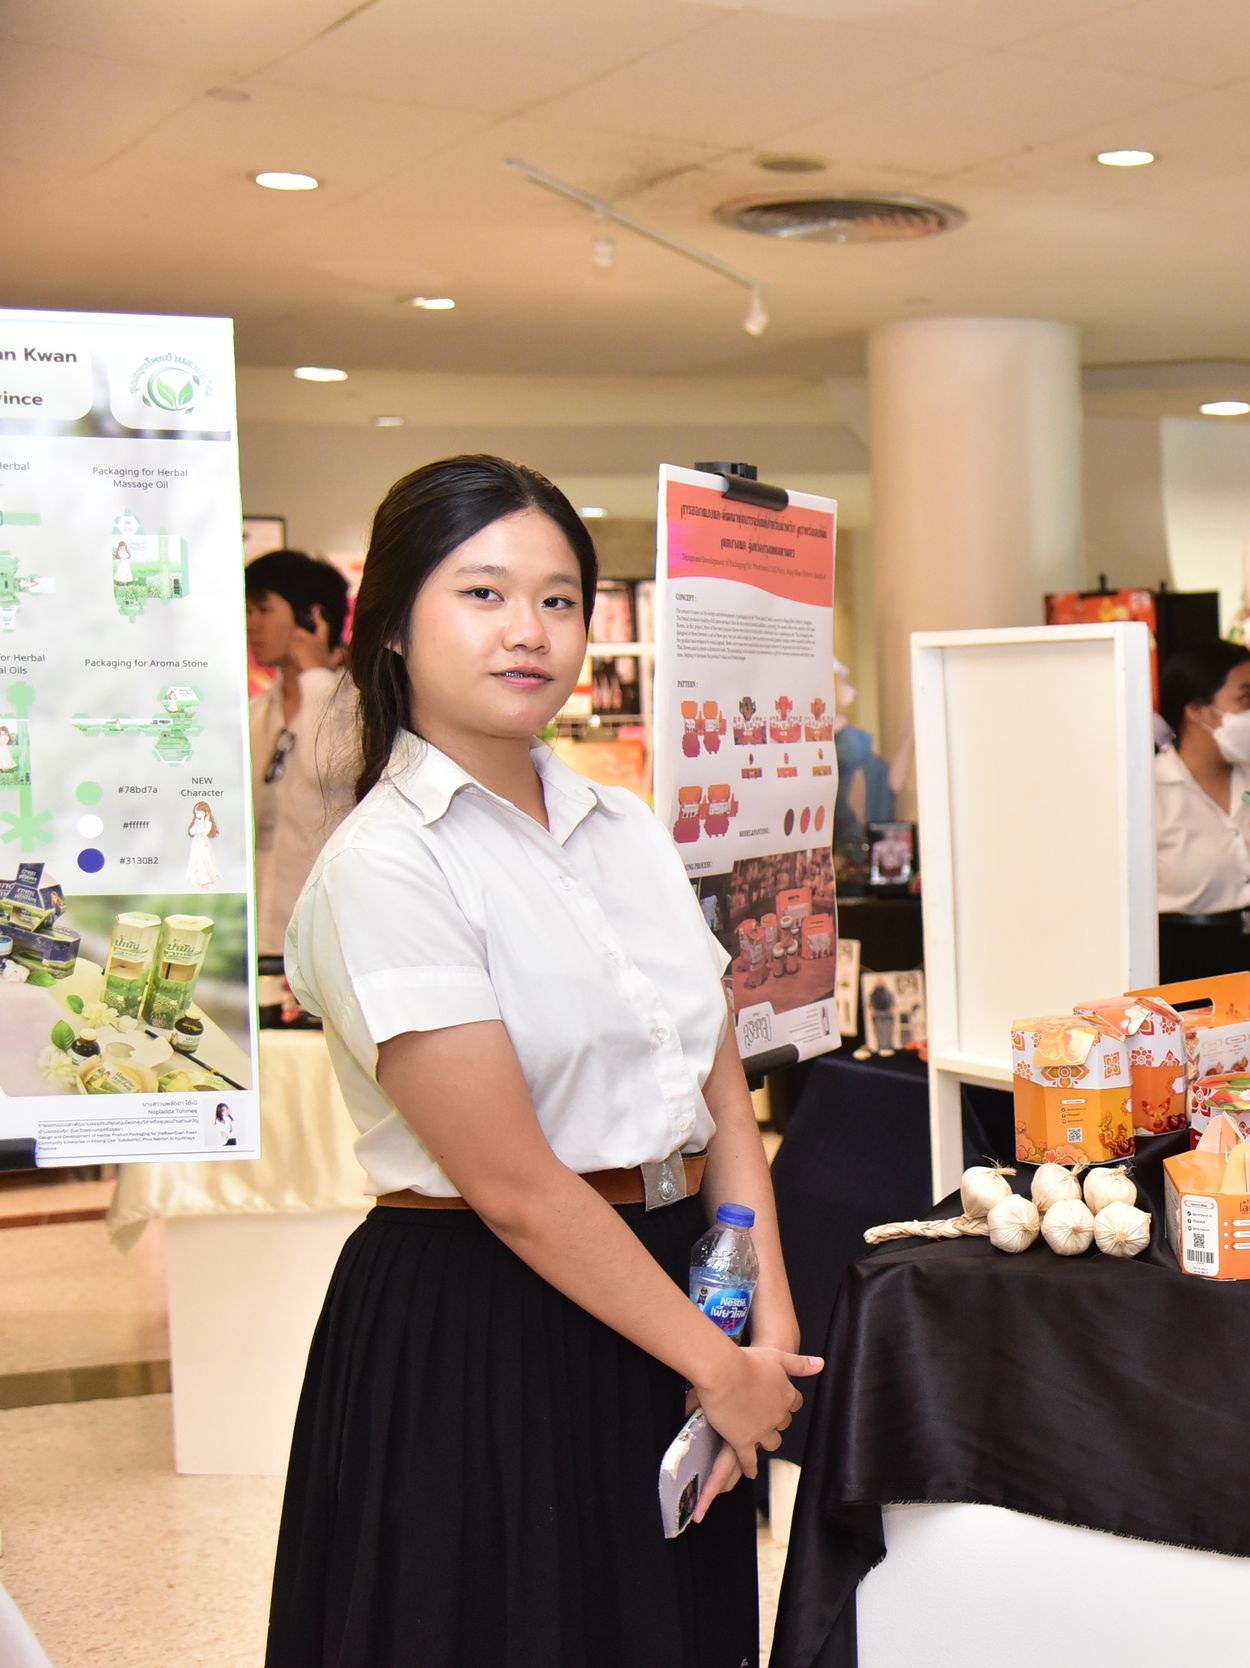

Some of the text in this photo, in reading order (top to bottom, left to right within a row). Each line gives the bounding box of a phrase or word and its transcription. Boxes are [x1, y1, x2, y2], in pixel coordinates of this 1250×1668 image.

[0, 347, 78, 363] n Kwan
[0, 390, 44, 406] ince
[92, 466, 188, 478] Packaging for Herbal
[113, 479, 169, 490] Massage Oil
[0, 653, 45, 662] or Herbal
[84, 659, 209, 669] Packaging for Aroma Stone
[9, 666, 28, 675] Oils
[191, 777, 213, 785] NEW
[118, 786, 158, 795] #78bd7a
[180, 789, 224, 797] Character
[122, 821, 150, 830] #ffffff
[119, 857, 159, 865] #313082
